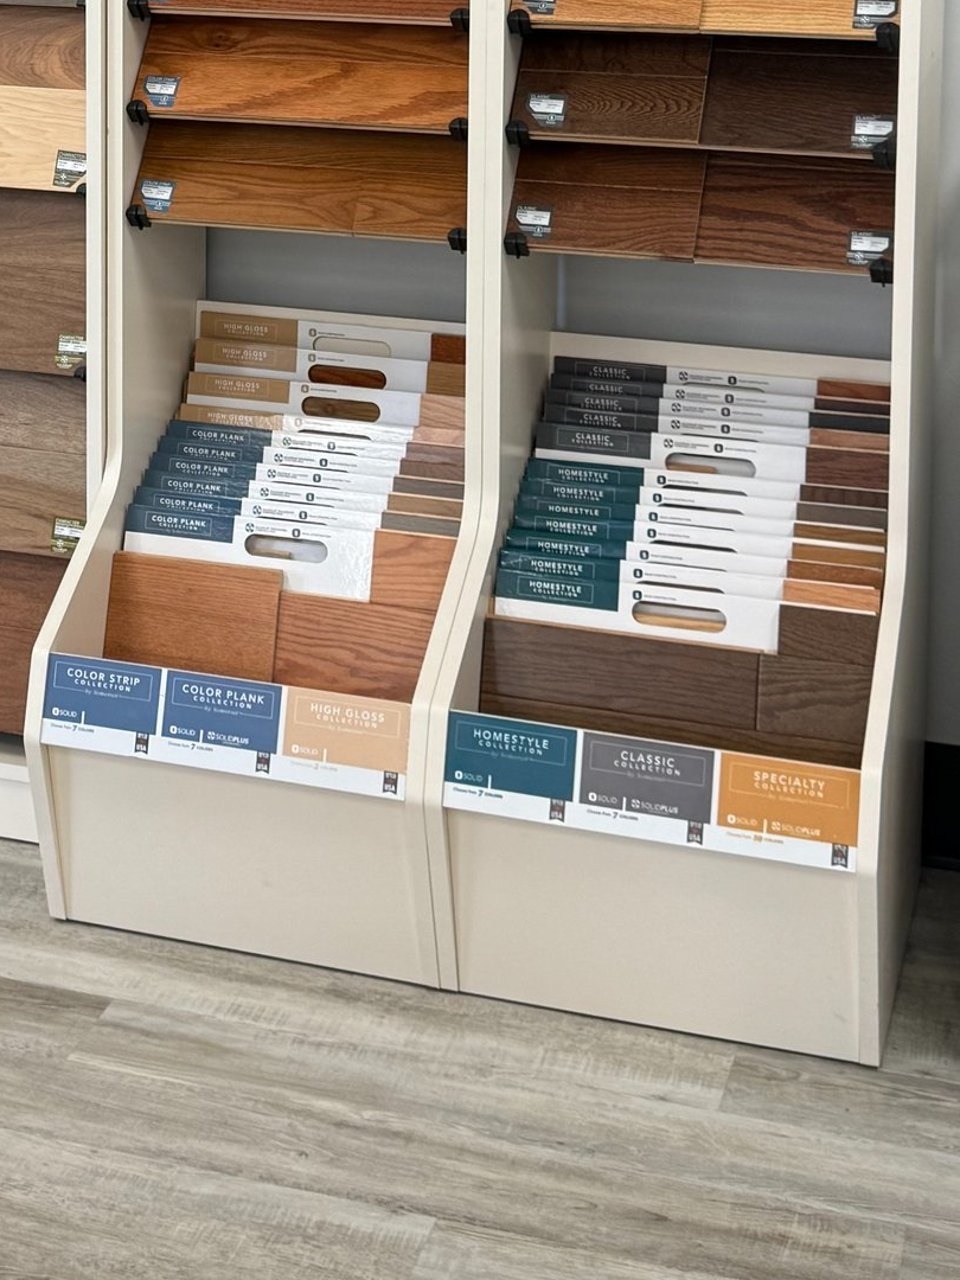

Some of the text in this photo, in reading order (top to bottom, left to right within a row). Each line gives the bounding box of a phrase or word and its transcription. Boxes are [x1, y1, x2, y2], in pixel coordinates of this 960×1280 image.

[243, 325, 268, 333] GLOSS
[243, 350, 267, 358] GLOSS
[593, 366, 627, 375] CLASSIC
[236, 381, 260, 389] GLOSS
[589, 384, 623, 393] CLASSIC
[584, 397, 619, 407] CLASSIC
[583, 414, 617, 423] CLASSIC
[192, 429, 217, 437] COLOR
[220, 432, 244, 441] PLANK
[575, 432, 610, 442] CLASSIC
[183, 446, 208, 454] COLOR
[211, 449, 236, 458] PLANK
[175, 462, 229, 474] COLOR PLANK
[558, 468, 608, 480] HOMESTYLE
[168, 480, 221, 492] COLOR PLANK
[553, 486, 603, 498] HOMESTYLE
[159, 498, 214, 510] COLOR PLANK
[548, 505, 599, 516] HOMESTYLE
[151, 515, 207, 527] COLOR PLANK
[546, 521, 598, 532] HOMESTYLE
[538, 541, 590, 553] HOMESTYLE
[531, 559, 583, 571] HOMESTYLE
[529, 580, 582, 593] HOMESTYLE
[66, 668, 140, 686] COLOR STRIP
[74, 678, 131, 692] COLLECTION
[182, 684, 265, 704] COLOR PLANK
[193, 695, 252, 709] COLLECTION
[310, 703, 385, 723] HIGH GLOSS
[316, 714, 378, 729] COLLECTION
[473, 728, 550, 749] HOMESTYLE
[478, 740, 543, 755] COLLECTION
[620, 750, 675, 768] CLASSIC
[613, 760, 681, 776] COLLECTION
[753, 770, 825, 791] SPECIALTY
[754, 781, 824, 799] COLLECTION
